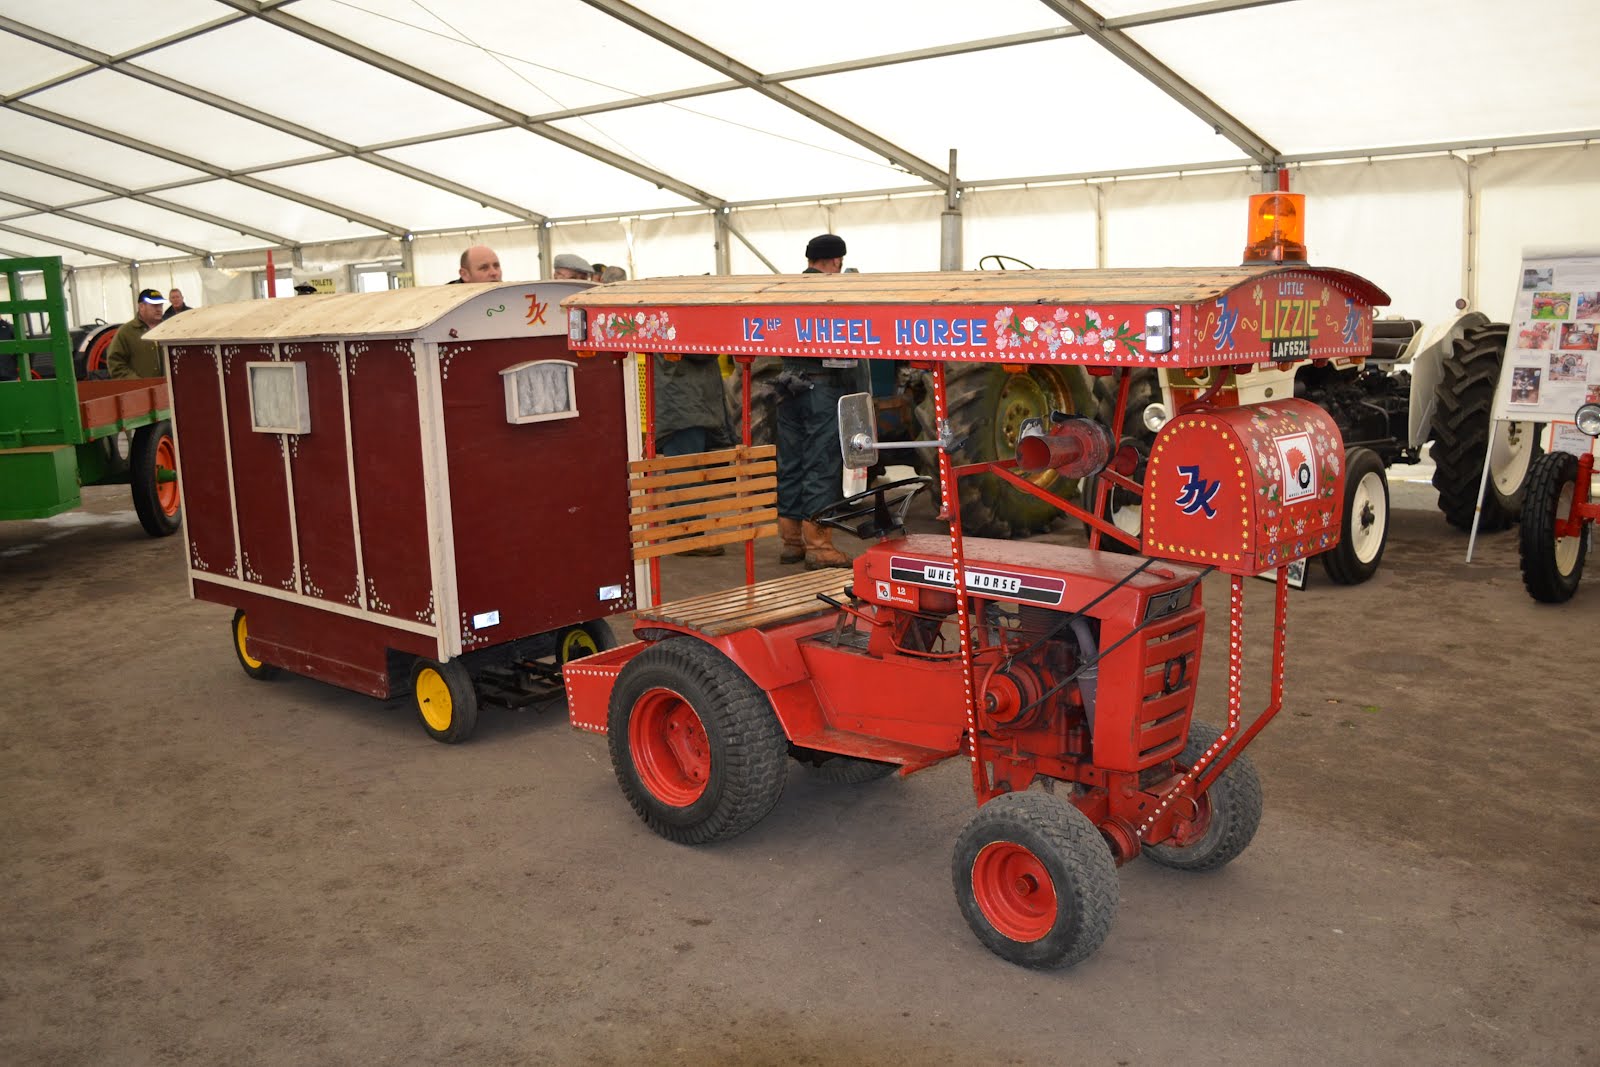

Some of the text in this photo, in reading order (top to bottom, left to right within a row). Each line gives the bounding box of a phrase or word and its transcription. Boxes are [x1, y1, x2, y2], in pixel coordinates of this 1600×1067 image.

[1278, 282, 1304, 295] LITTLE
[1260, 300, 1321, 341] LIZZIE
[794, 317, 881, 344] WHEEL
[895, 319, 988, 346] HORSE
[1272, 340, 1309, 358] LAF652L
[928, 568, 1016, 591] WHE HORSE
[896, 586, 906, 596] 12
